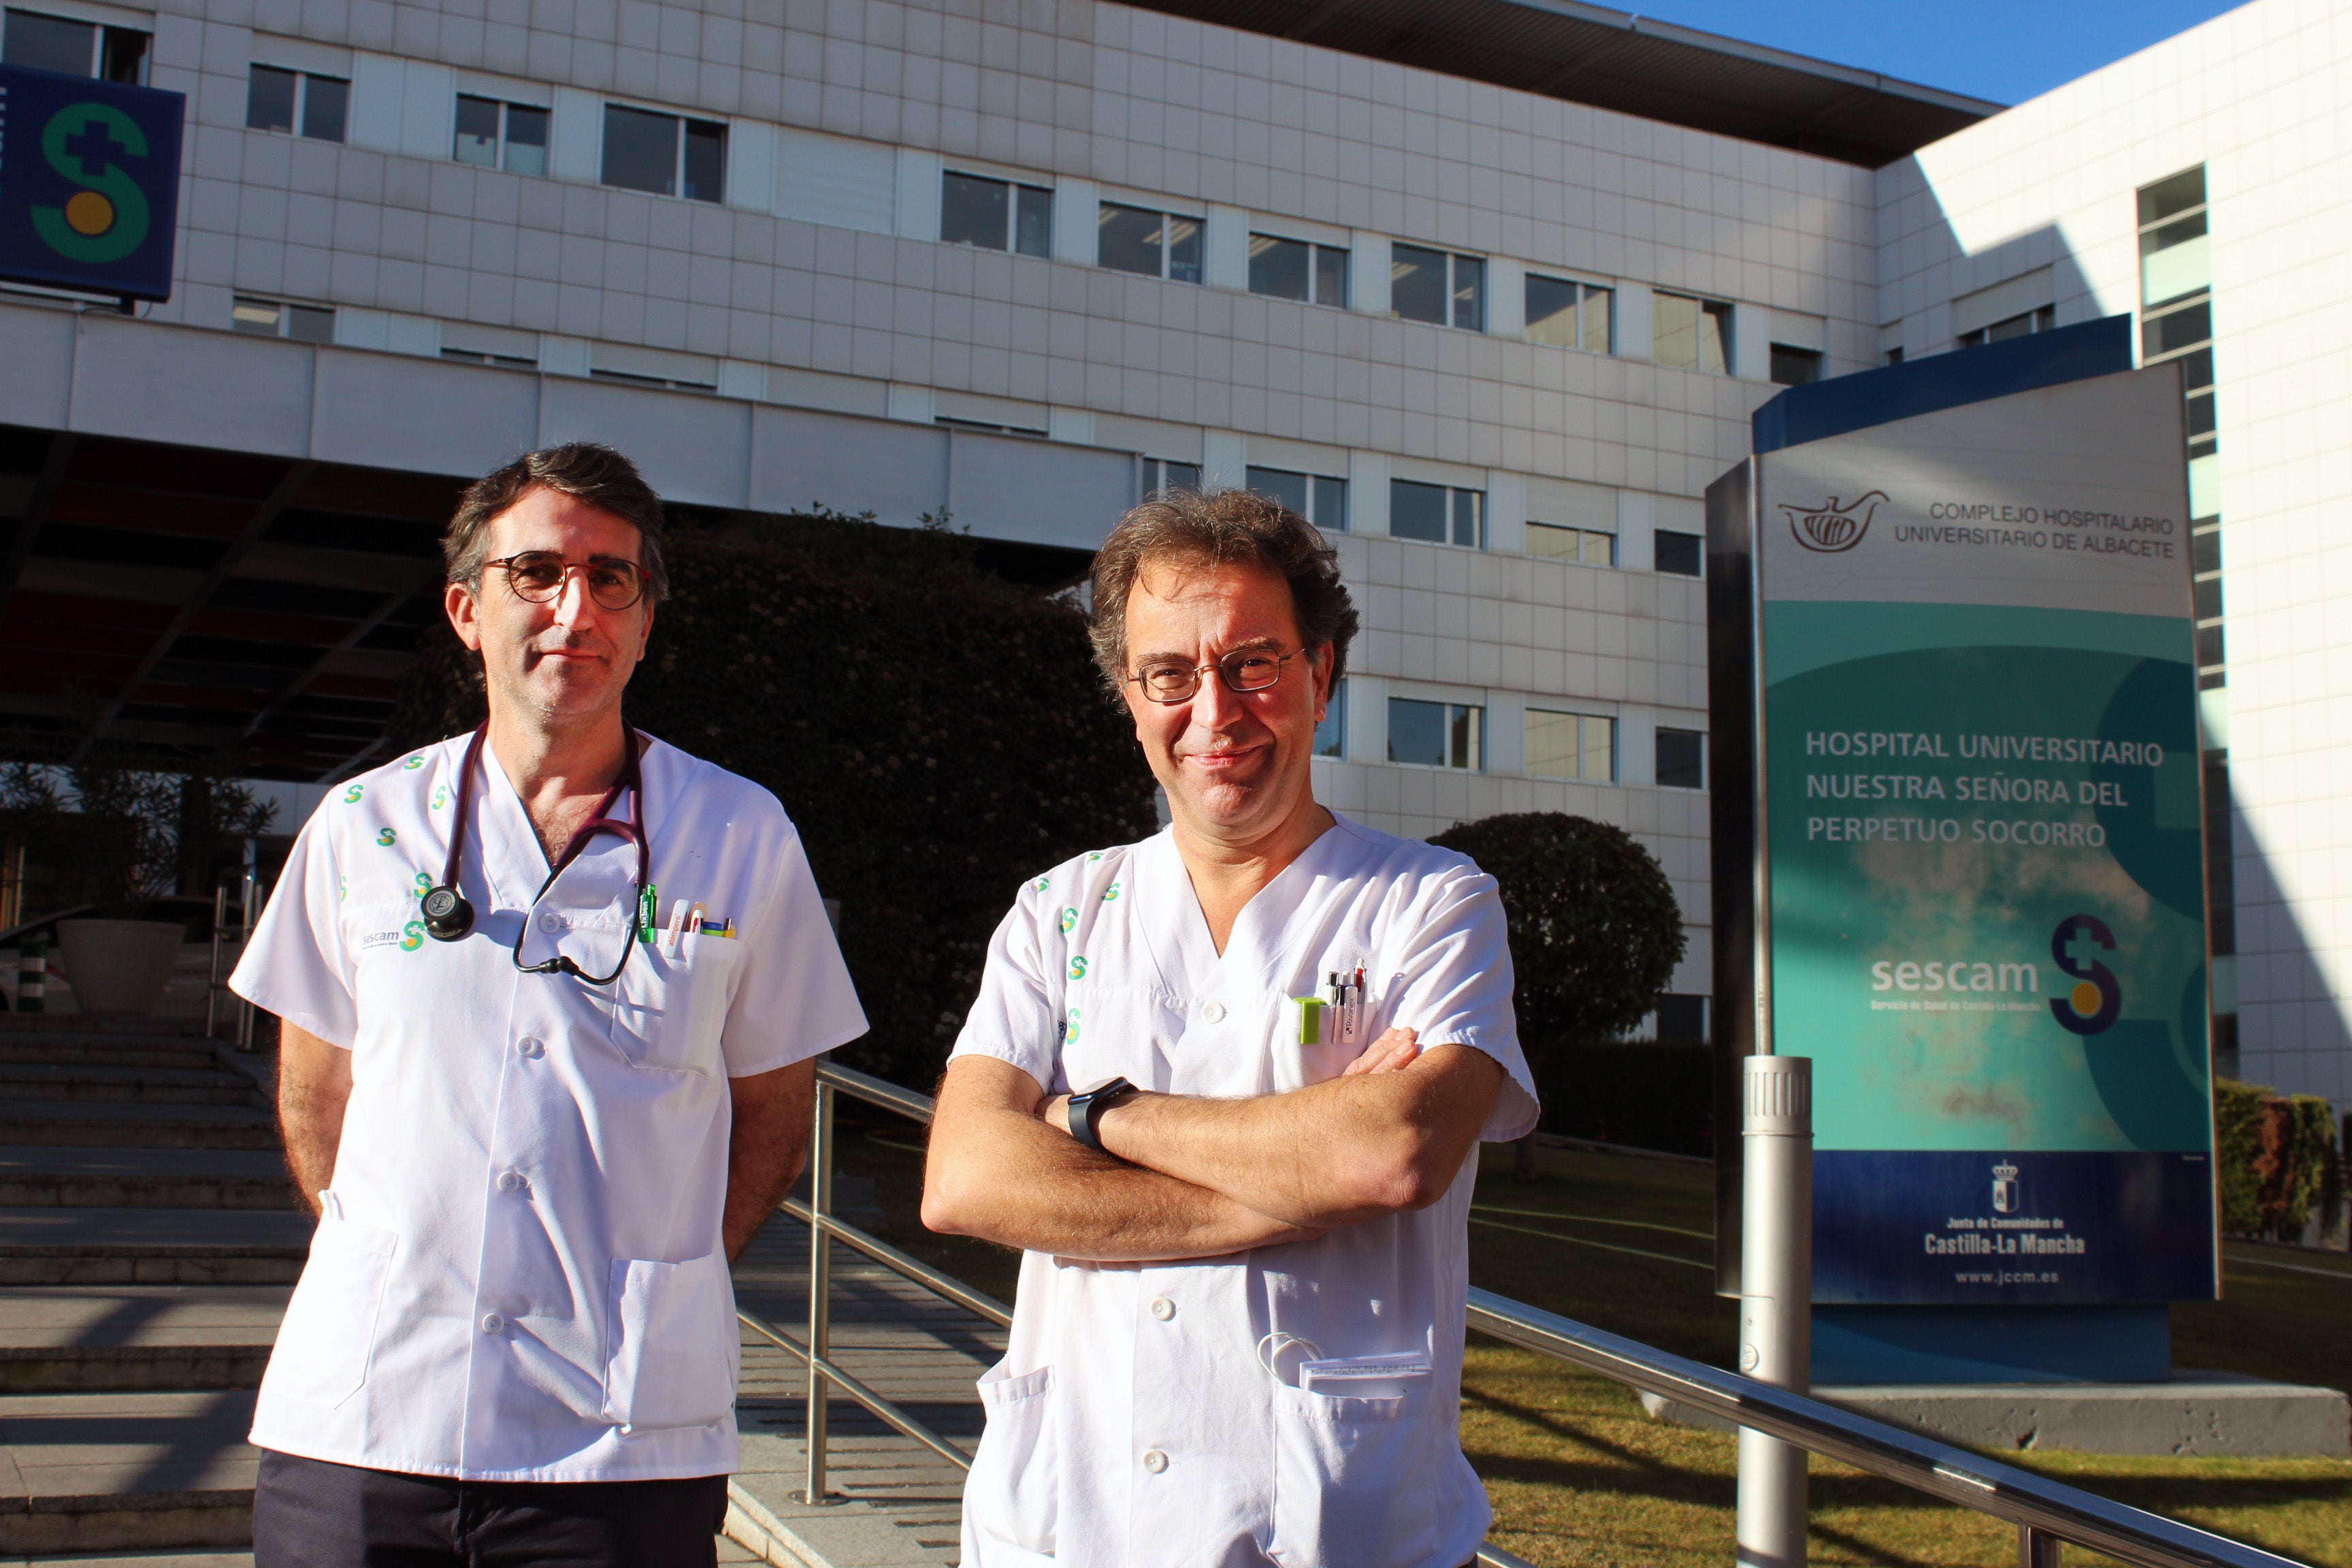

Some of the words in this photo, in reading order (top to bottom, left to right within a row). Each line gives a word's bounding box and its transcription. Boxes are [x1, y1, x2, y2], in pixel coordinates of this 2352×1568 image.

[1930, 502, 2039, 524] COMPLEJO
[2043, 509, 2174, 536] HOSPITALARIO
[1895, 525, 2047, 549] UNIVERSITARIO
[2053, 532, 2077, 551] DE
[2082, 536, 2174, 558] ALBACETE
[1806, 732, 1950, 757] HOSPITAL
[1959, 734, 2163, 766] UNIVERSITARIO
[1806, 774, 1946, 800] NUESTRA
[1955, 772, 2071, 804] SEÑORA
[2079, 781, 2128, 806] DEL
[1808, 817, 1960, 843] PERPETUO
[1972, 819, 2106, 847] SOCORRO
[363, 931, 399, 945] sescam
[1872, 961, 2038, 992] sescam
[1946, 1217, 1975, 1229] Junta
[1977, 1217, 1989, 1229] de
[1991, 1217, 2051, 1229] Comunidades
[2053, 1218, 2064, 1229] de
[1925, 1233, 2016, 1254] Castilla-La
[2021, 1233, 2086, 1254] Mancha
[1955, 1270, 2059, 1286] www.jccm.es
